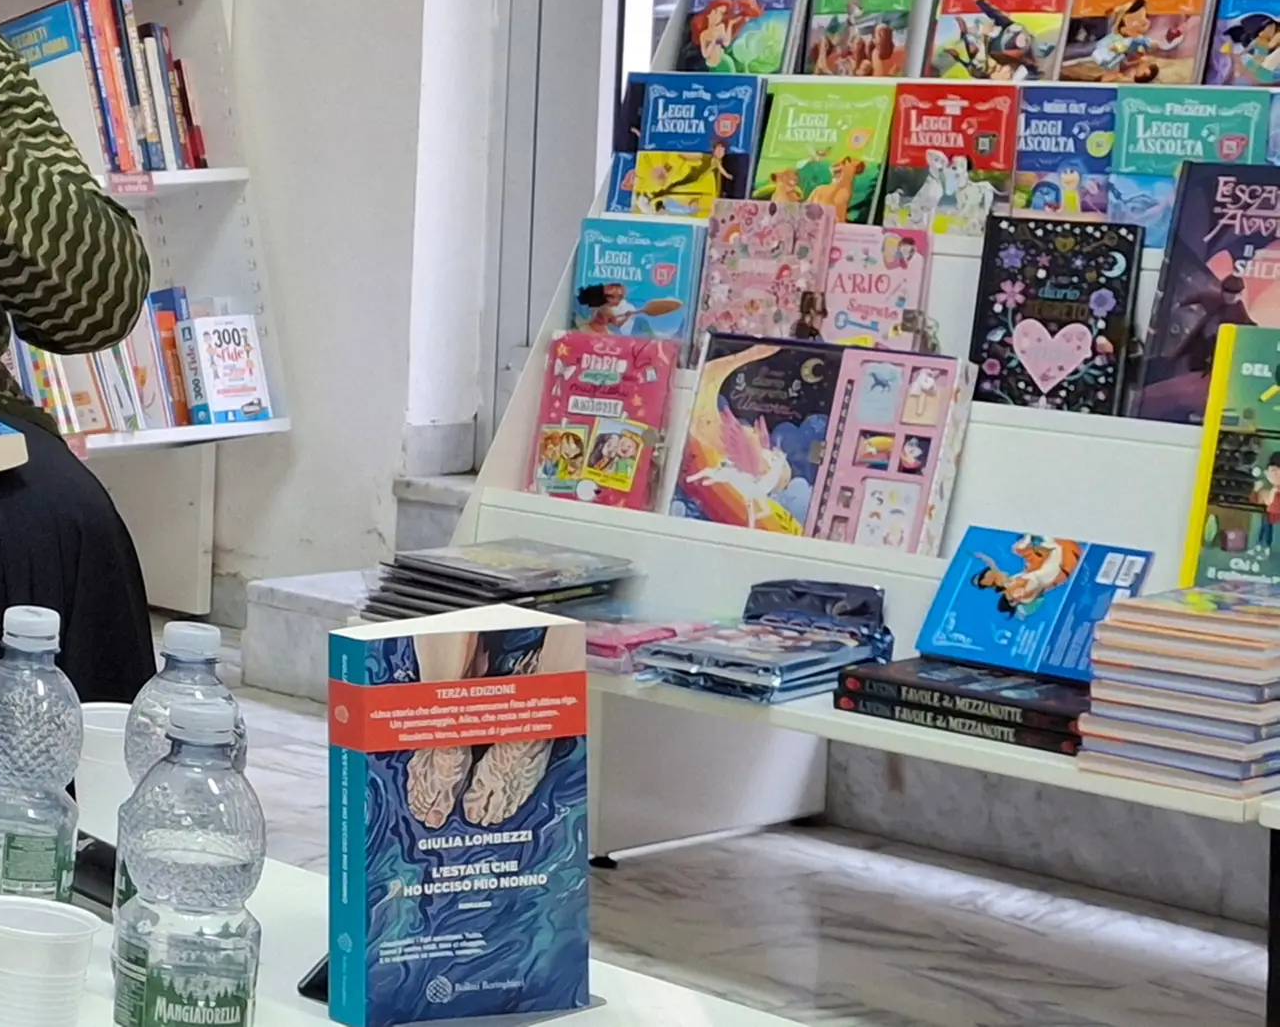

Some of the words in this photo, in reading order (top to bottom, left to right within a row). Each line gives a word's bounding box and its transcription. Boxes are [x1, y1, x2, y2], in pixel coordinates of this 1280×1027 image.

[657, 98, 695, 120] LEGGI
[787, 107, 829, 129] LEGGI
[1164, 102, 1217, 117] FROZEN
[655, 119, 706, 135] ASCOLTA
[909, 109, 953, 133] LEGGI
[1018, 113, 1063, 137] LEGGI
[1135, 114, 1190, 138] LEGGI
[785, 127, 838, 143] ASCOLTA
[908, 131, 965, 149] ASCOLTA
[1017, 136, 1076, 154] ASCOLTA
[1137, 136, 1204, 157] ASCOLTA
[593, 244, 632, 266] LEGGI
[590, 263, 643, 282] ASCOLTA
[211, 328, 241, 349] 300
[1241, 362, 1272, 378] DEL
[435, 687, 469, 699] TERZA
[470, 683, 516, 698] EDIZIONE
[900, 685, 942, 707] FAVOLE
[954, 695, 1025, 724] MEZZANOTTE
[893, 706, 935, 727] FAVOLE
[947, 716, 1017, 743] MEZZANOTTE
[417, 836, 463, 851] GIULIA
[464, 829, 534, 847] LOMBEZZI
[431, 862, 491, 879] L'ESTATE
[491, 860, 519, 873] CHE
[403, 883, 423, 897] HO
[423, 879, 472, 895] UCCISO
[473, 876, 498, 890] MIO
[498, 873, 548, 889] NONNO
